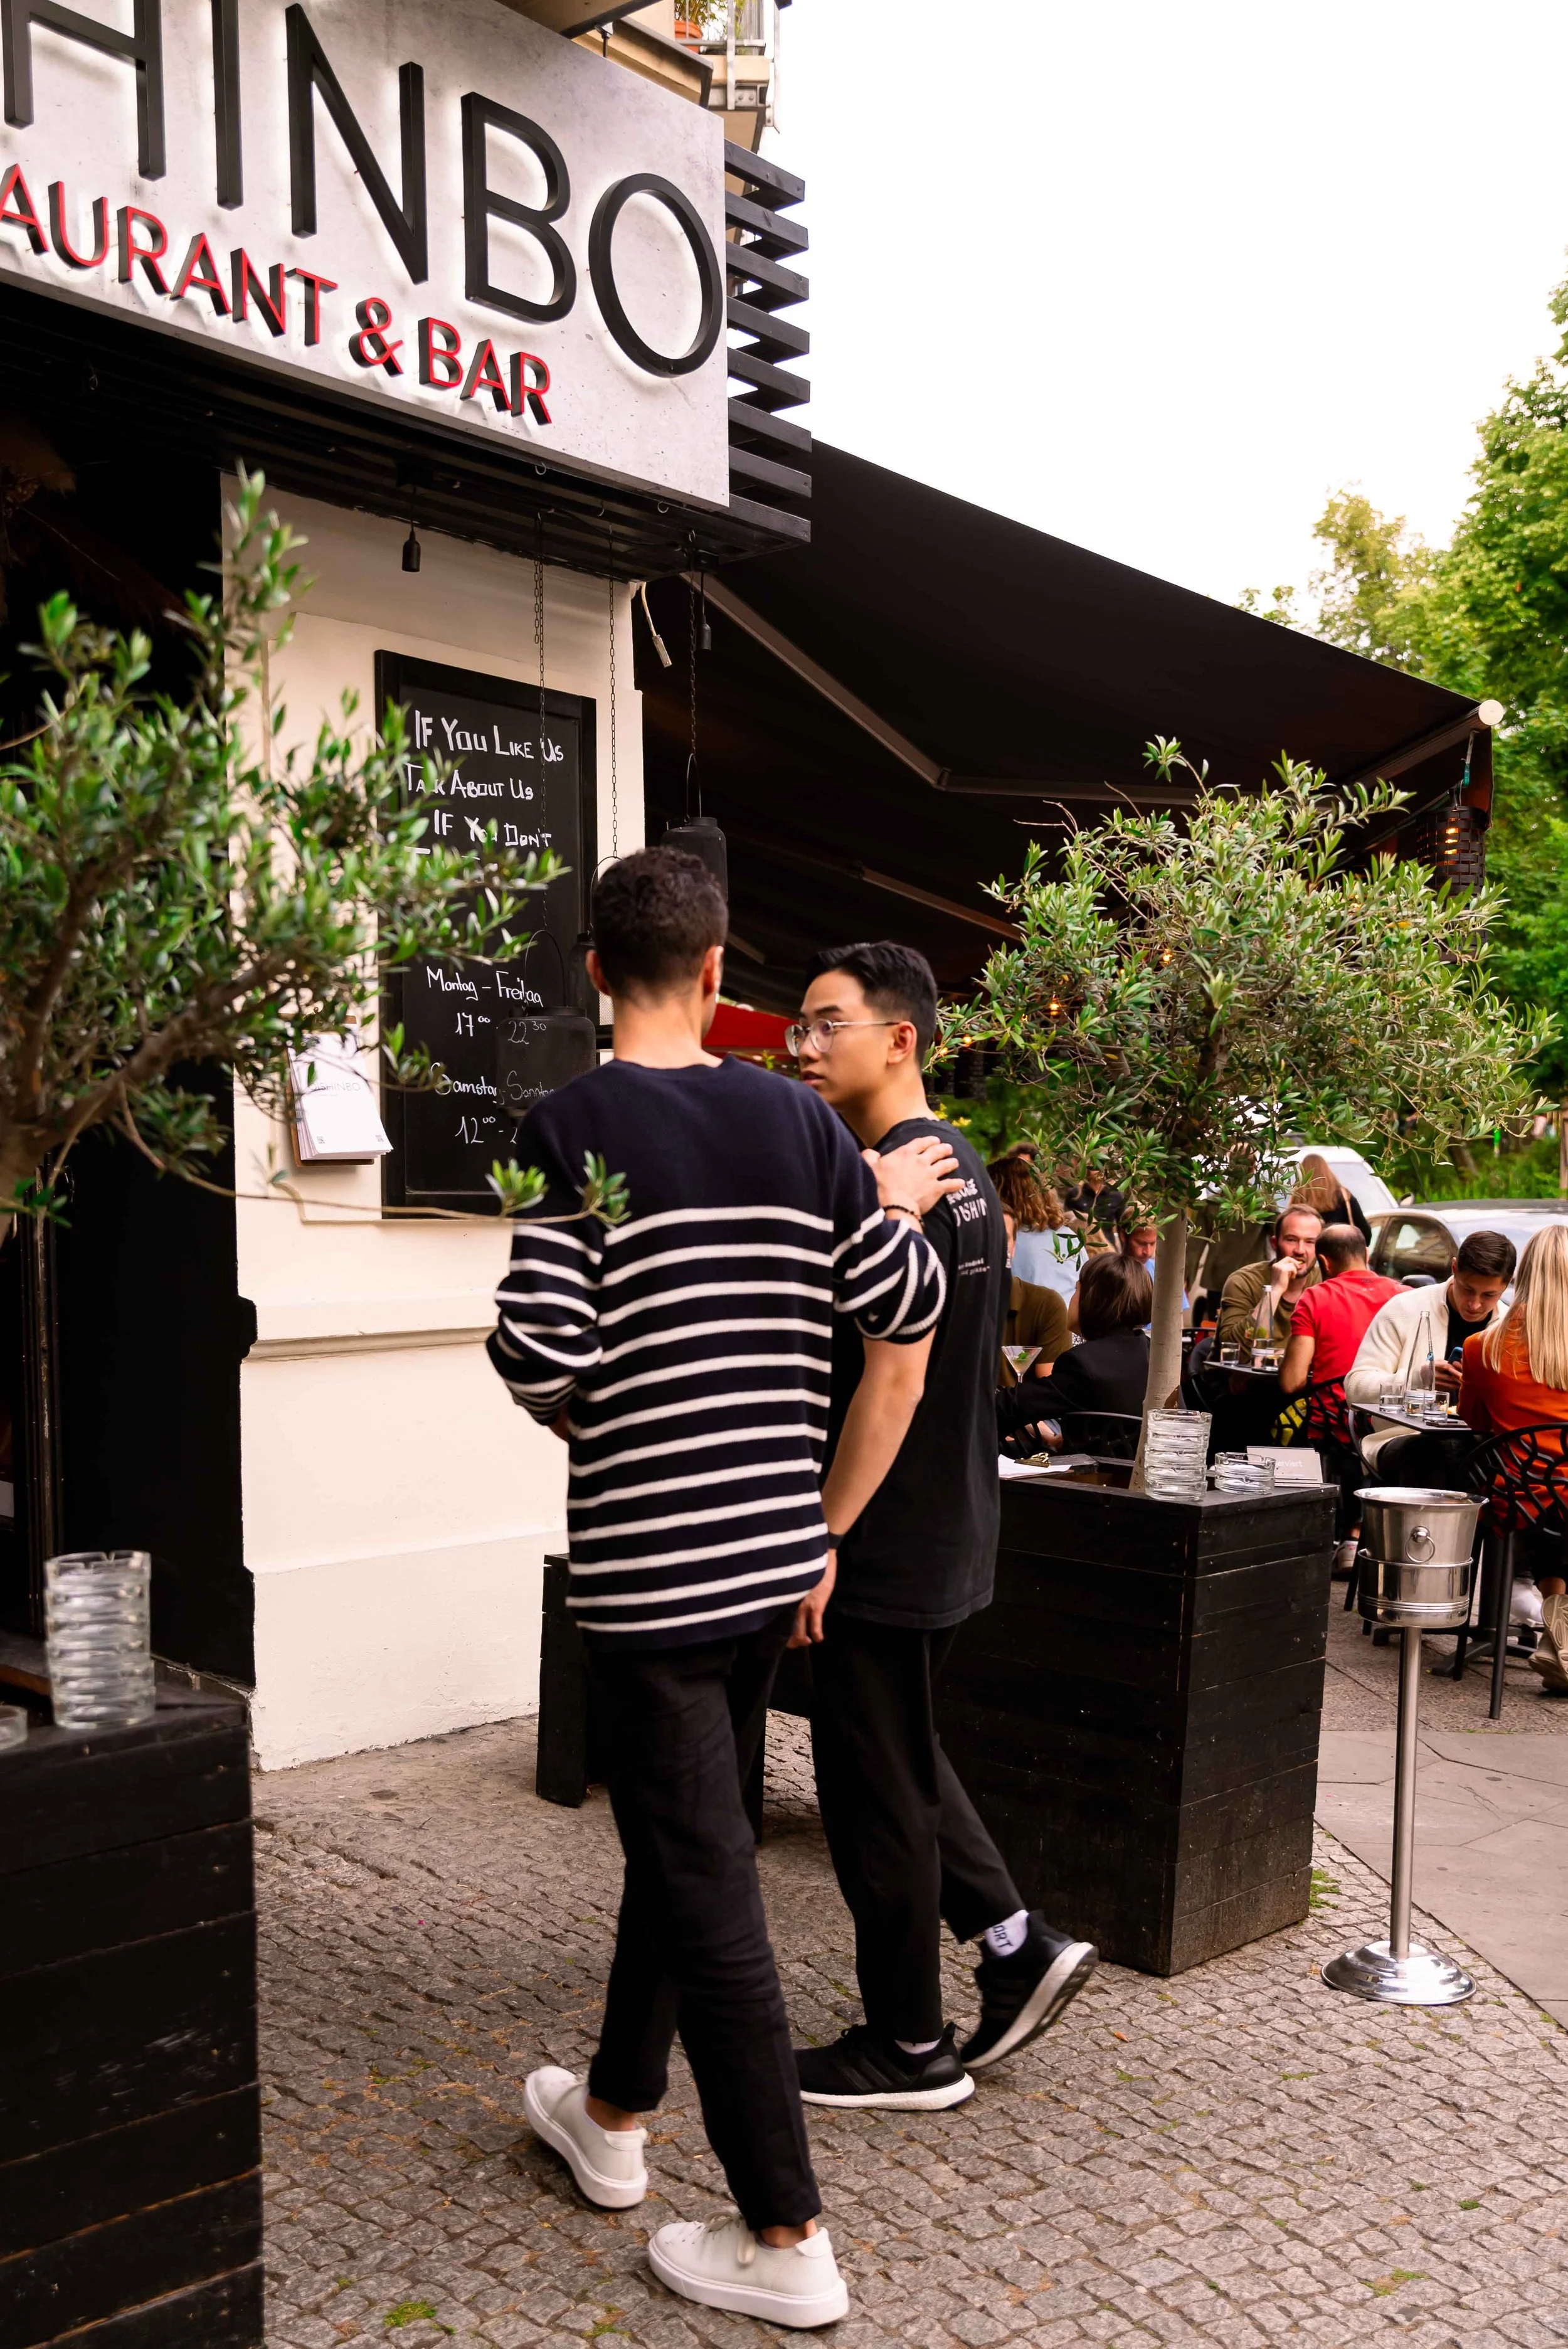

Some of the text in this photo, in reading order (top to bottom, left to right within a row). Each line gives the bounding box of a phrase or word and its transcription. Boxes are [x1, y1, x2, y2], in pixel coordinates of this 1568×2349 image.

[3, 0, 724, 378] HINBO
[0, 163, 551, 425] AURANT & BAR
[415, 709, 433, 749] IF
[403, 762, 445, 795] TAK
[434, 809, 454, 835] IF
[426, 965, 479, 1001] Montag
[495, 970, 544, 1007] Freitag
